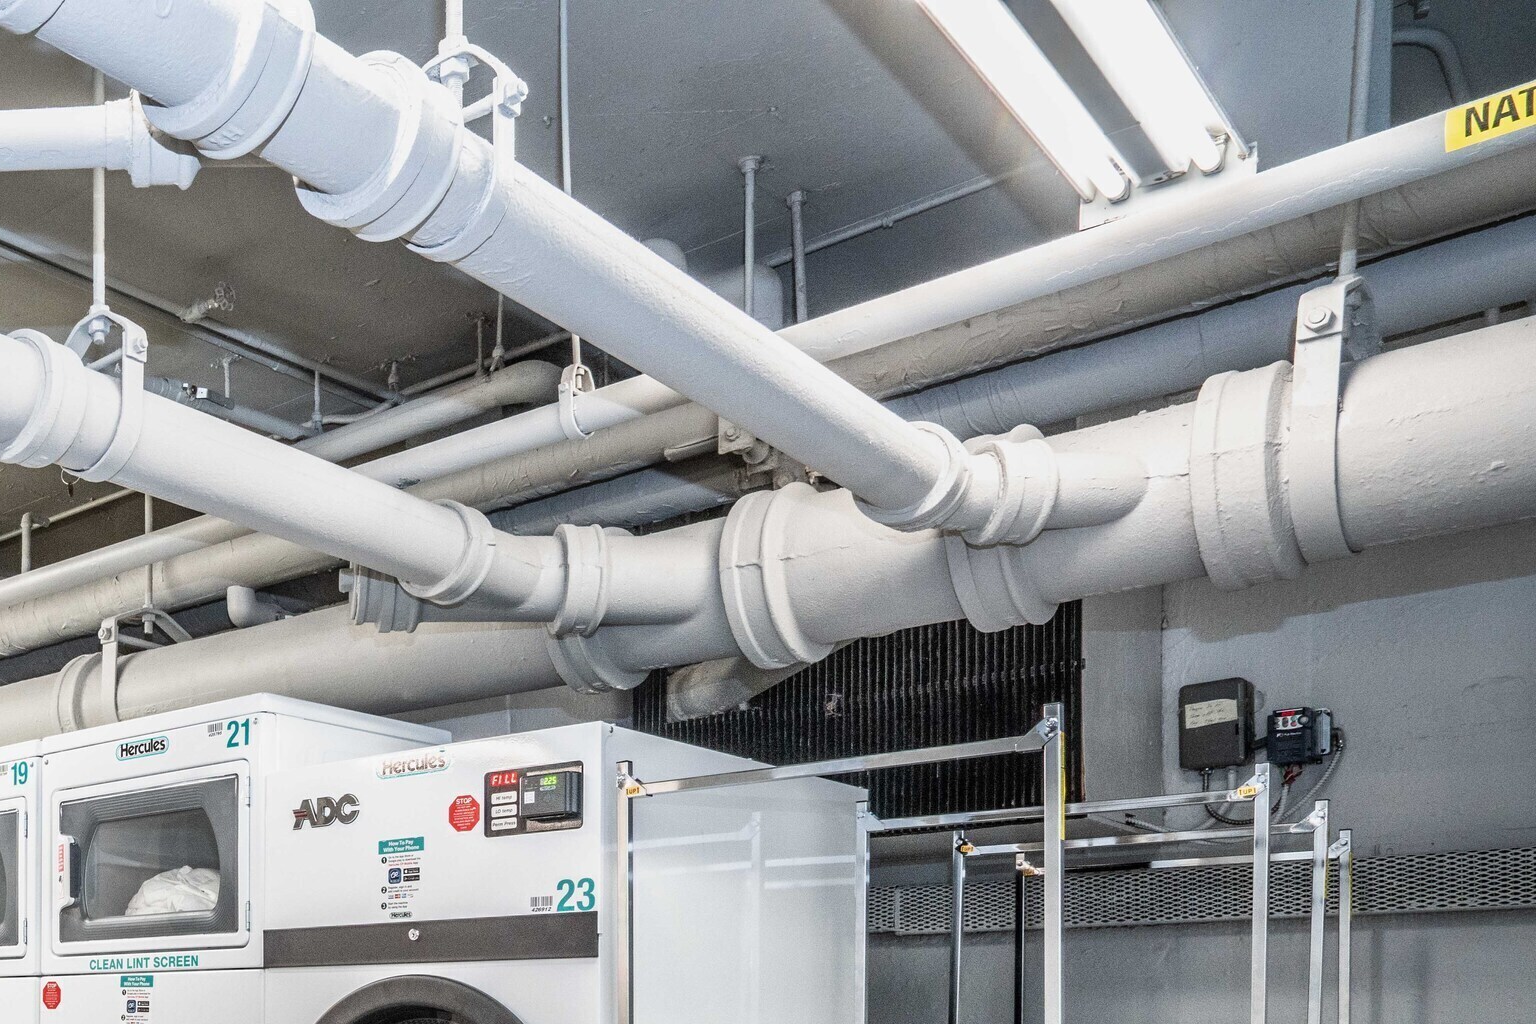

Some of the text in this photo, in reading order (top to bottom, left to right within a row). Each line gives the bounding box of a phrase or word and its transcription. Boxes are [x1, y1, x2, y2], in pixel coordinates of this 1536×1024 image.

[1465, 86, 1536, 137] NAT
[225, 718, 250, 748] 21
[120, 739, 166, 757] Hercules
[11, 761, 28, 785] 19
[382, 752, 446, 775] Hercules
[492, 774, 517, 785] FILL
[293, 793, 360, 830] ADC
[556, 878, 596, 912] 23
[90, 955, 199, 970] CLEAN LINT SCREEN
